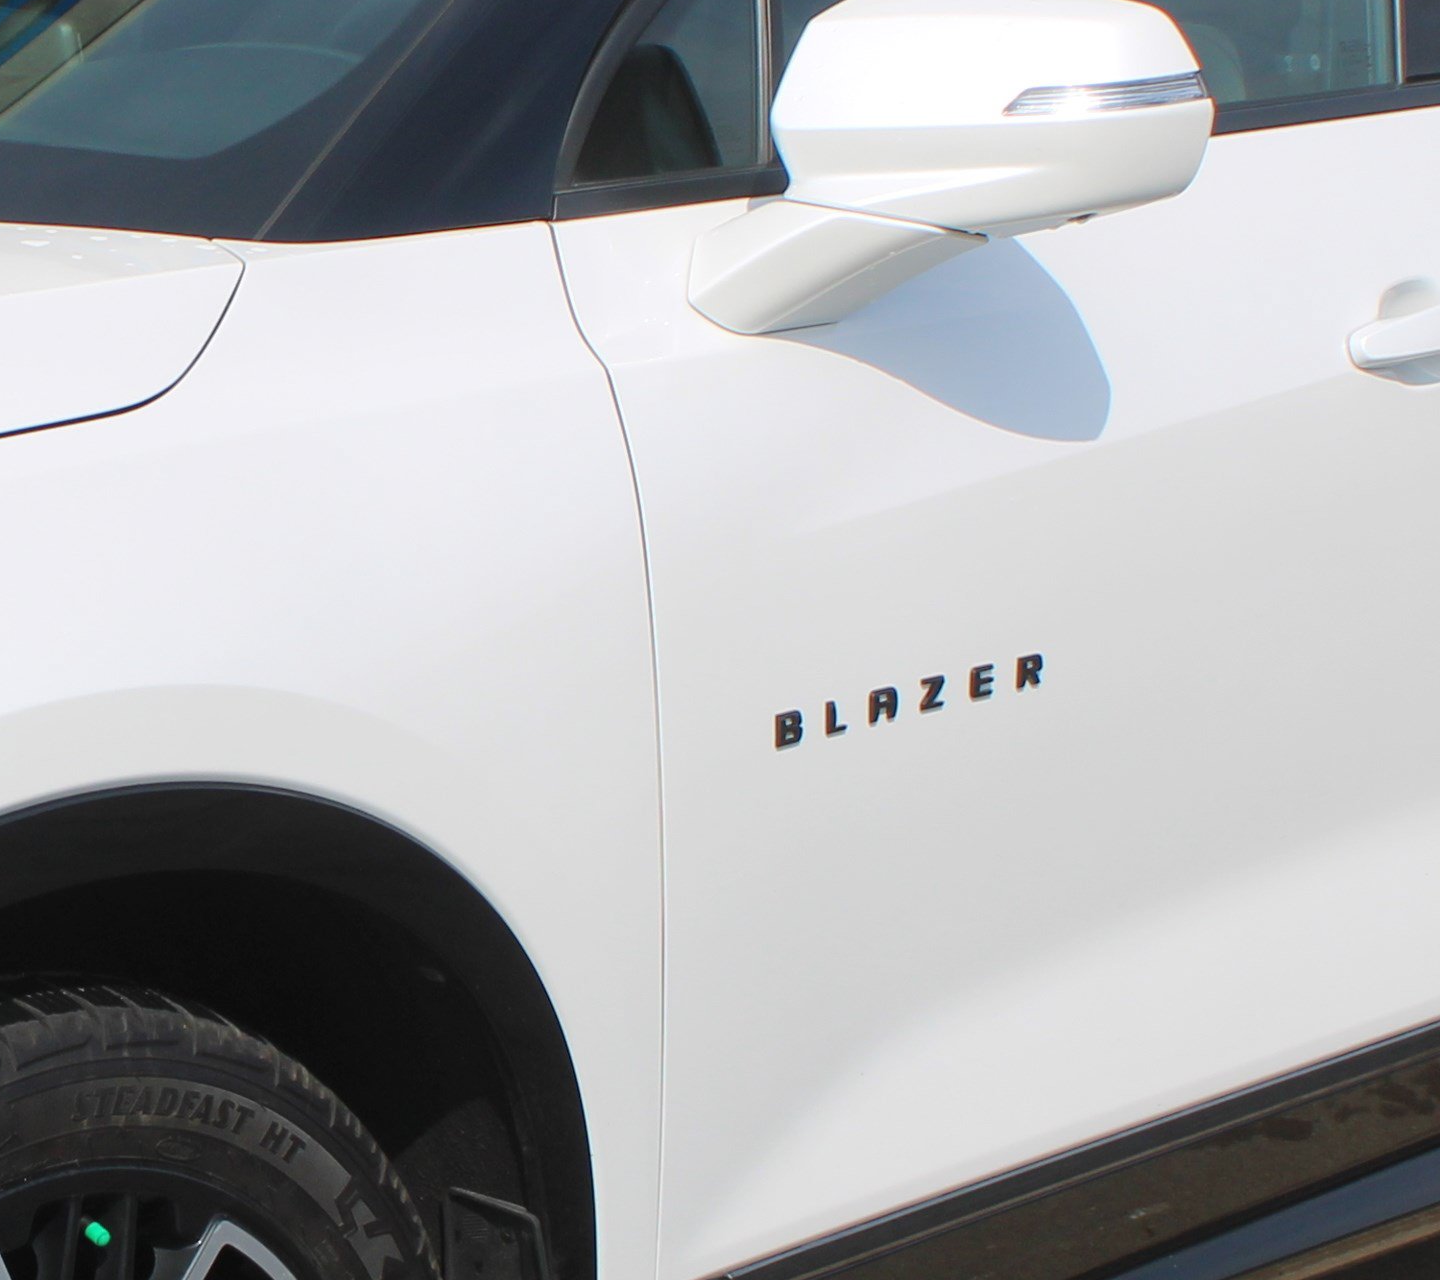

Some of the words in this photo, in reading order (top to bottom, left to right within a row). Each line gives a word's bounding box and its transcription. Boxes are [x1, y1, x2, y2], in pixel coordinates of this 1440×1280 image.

[773, 652, 1045, 752] BLAZER
[70, 1084, 256, 1138] STEADFAST
[259, 1118, 308, 1165] HT
